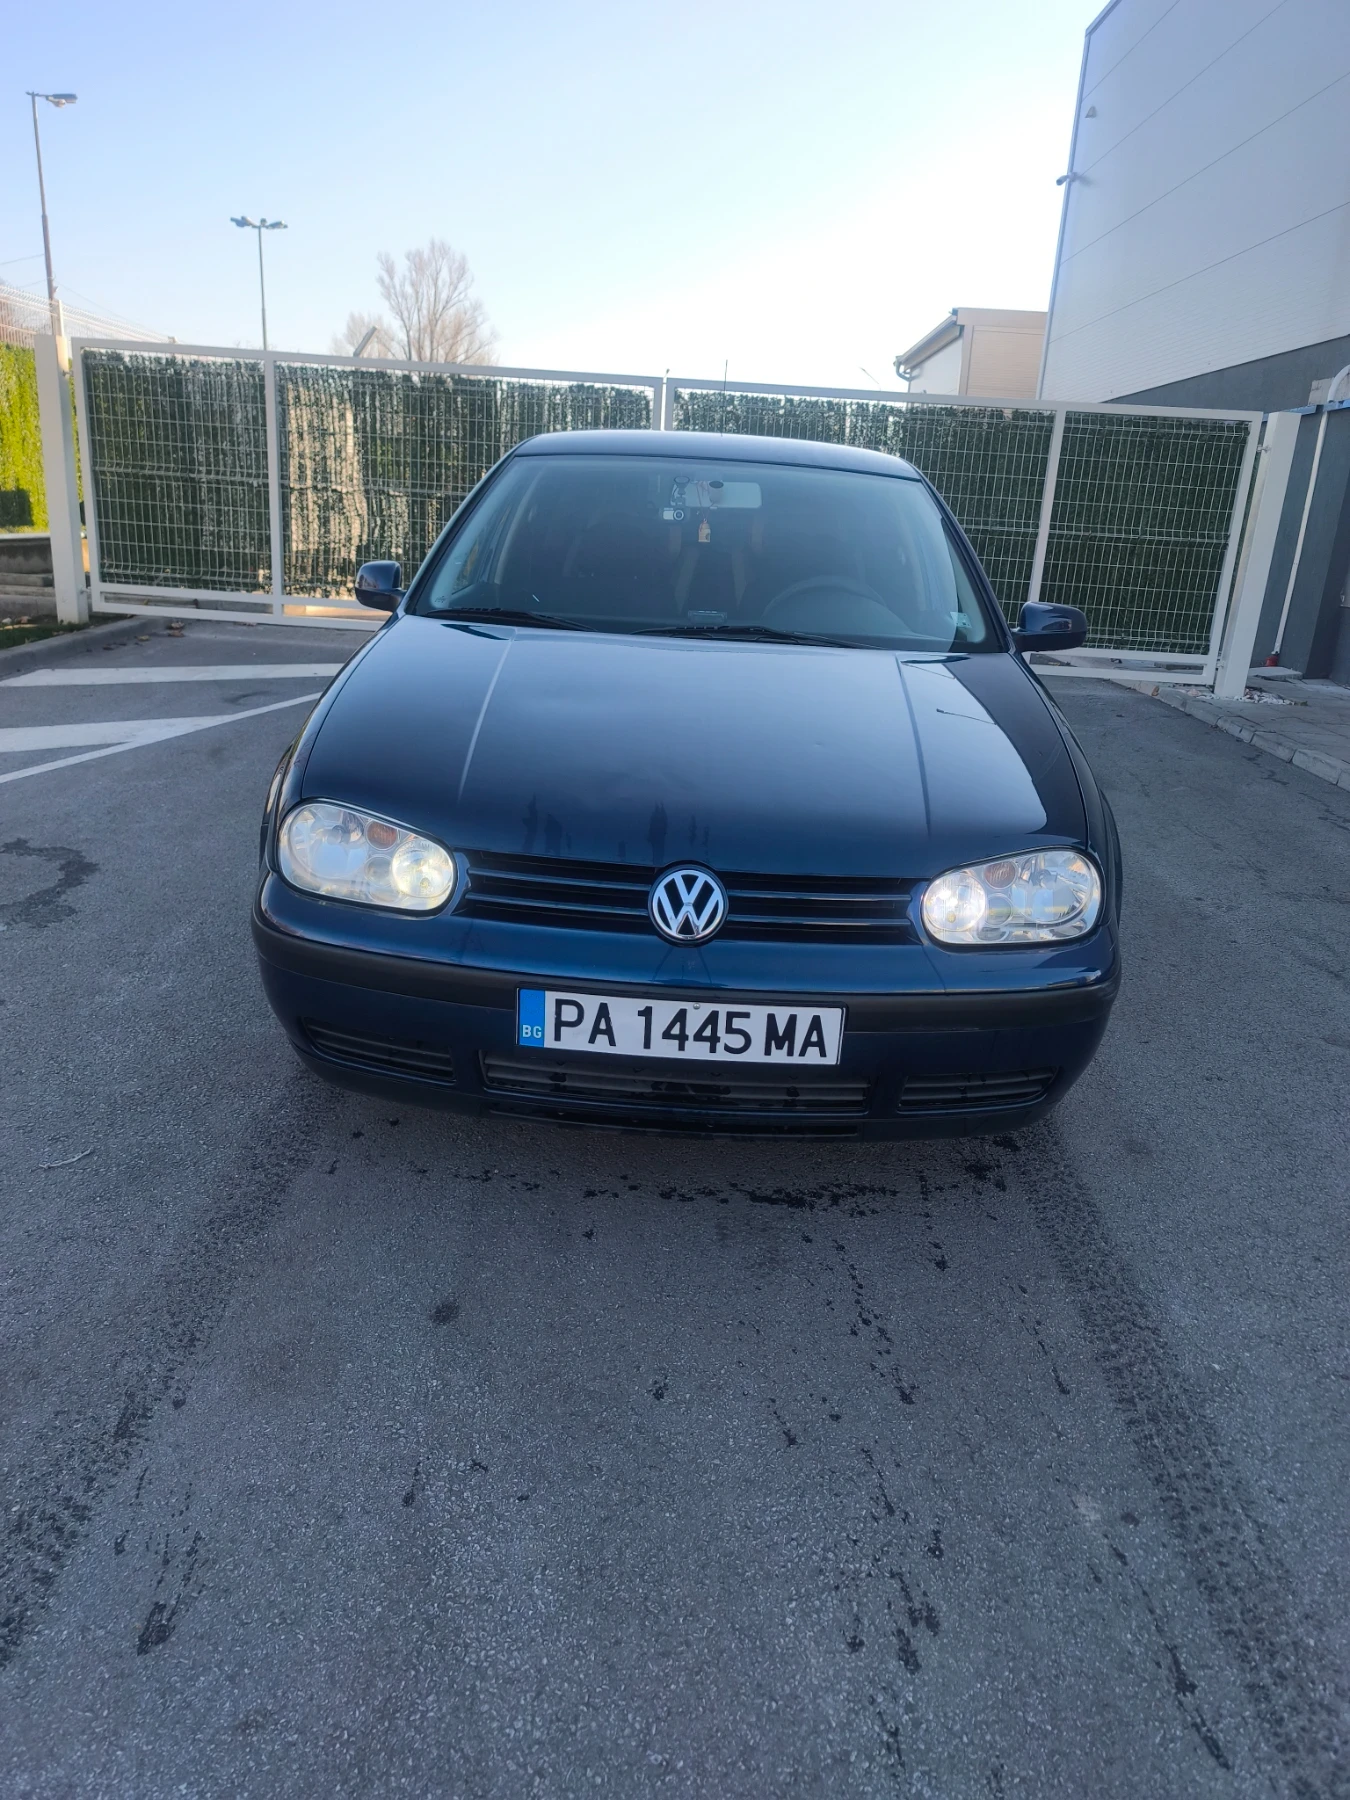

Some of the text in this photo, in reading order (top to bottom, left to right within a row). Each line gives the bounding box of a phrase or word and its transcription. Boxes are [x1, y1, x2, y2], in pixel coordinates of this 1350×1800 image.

[522, 1024, 542, 1039] BG
[553, 998, 828, 1058] PA 1445 MA
